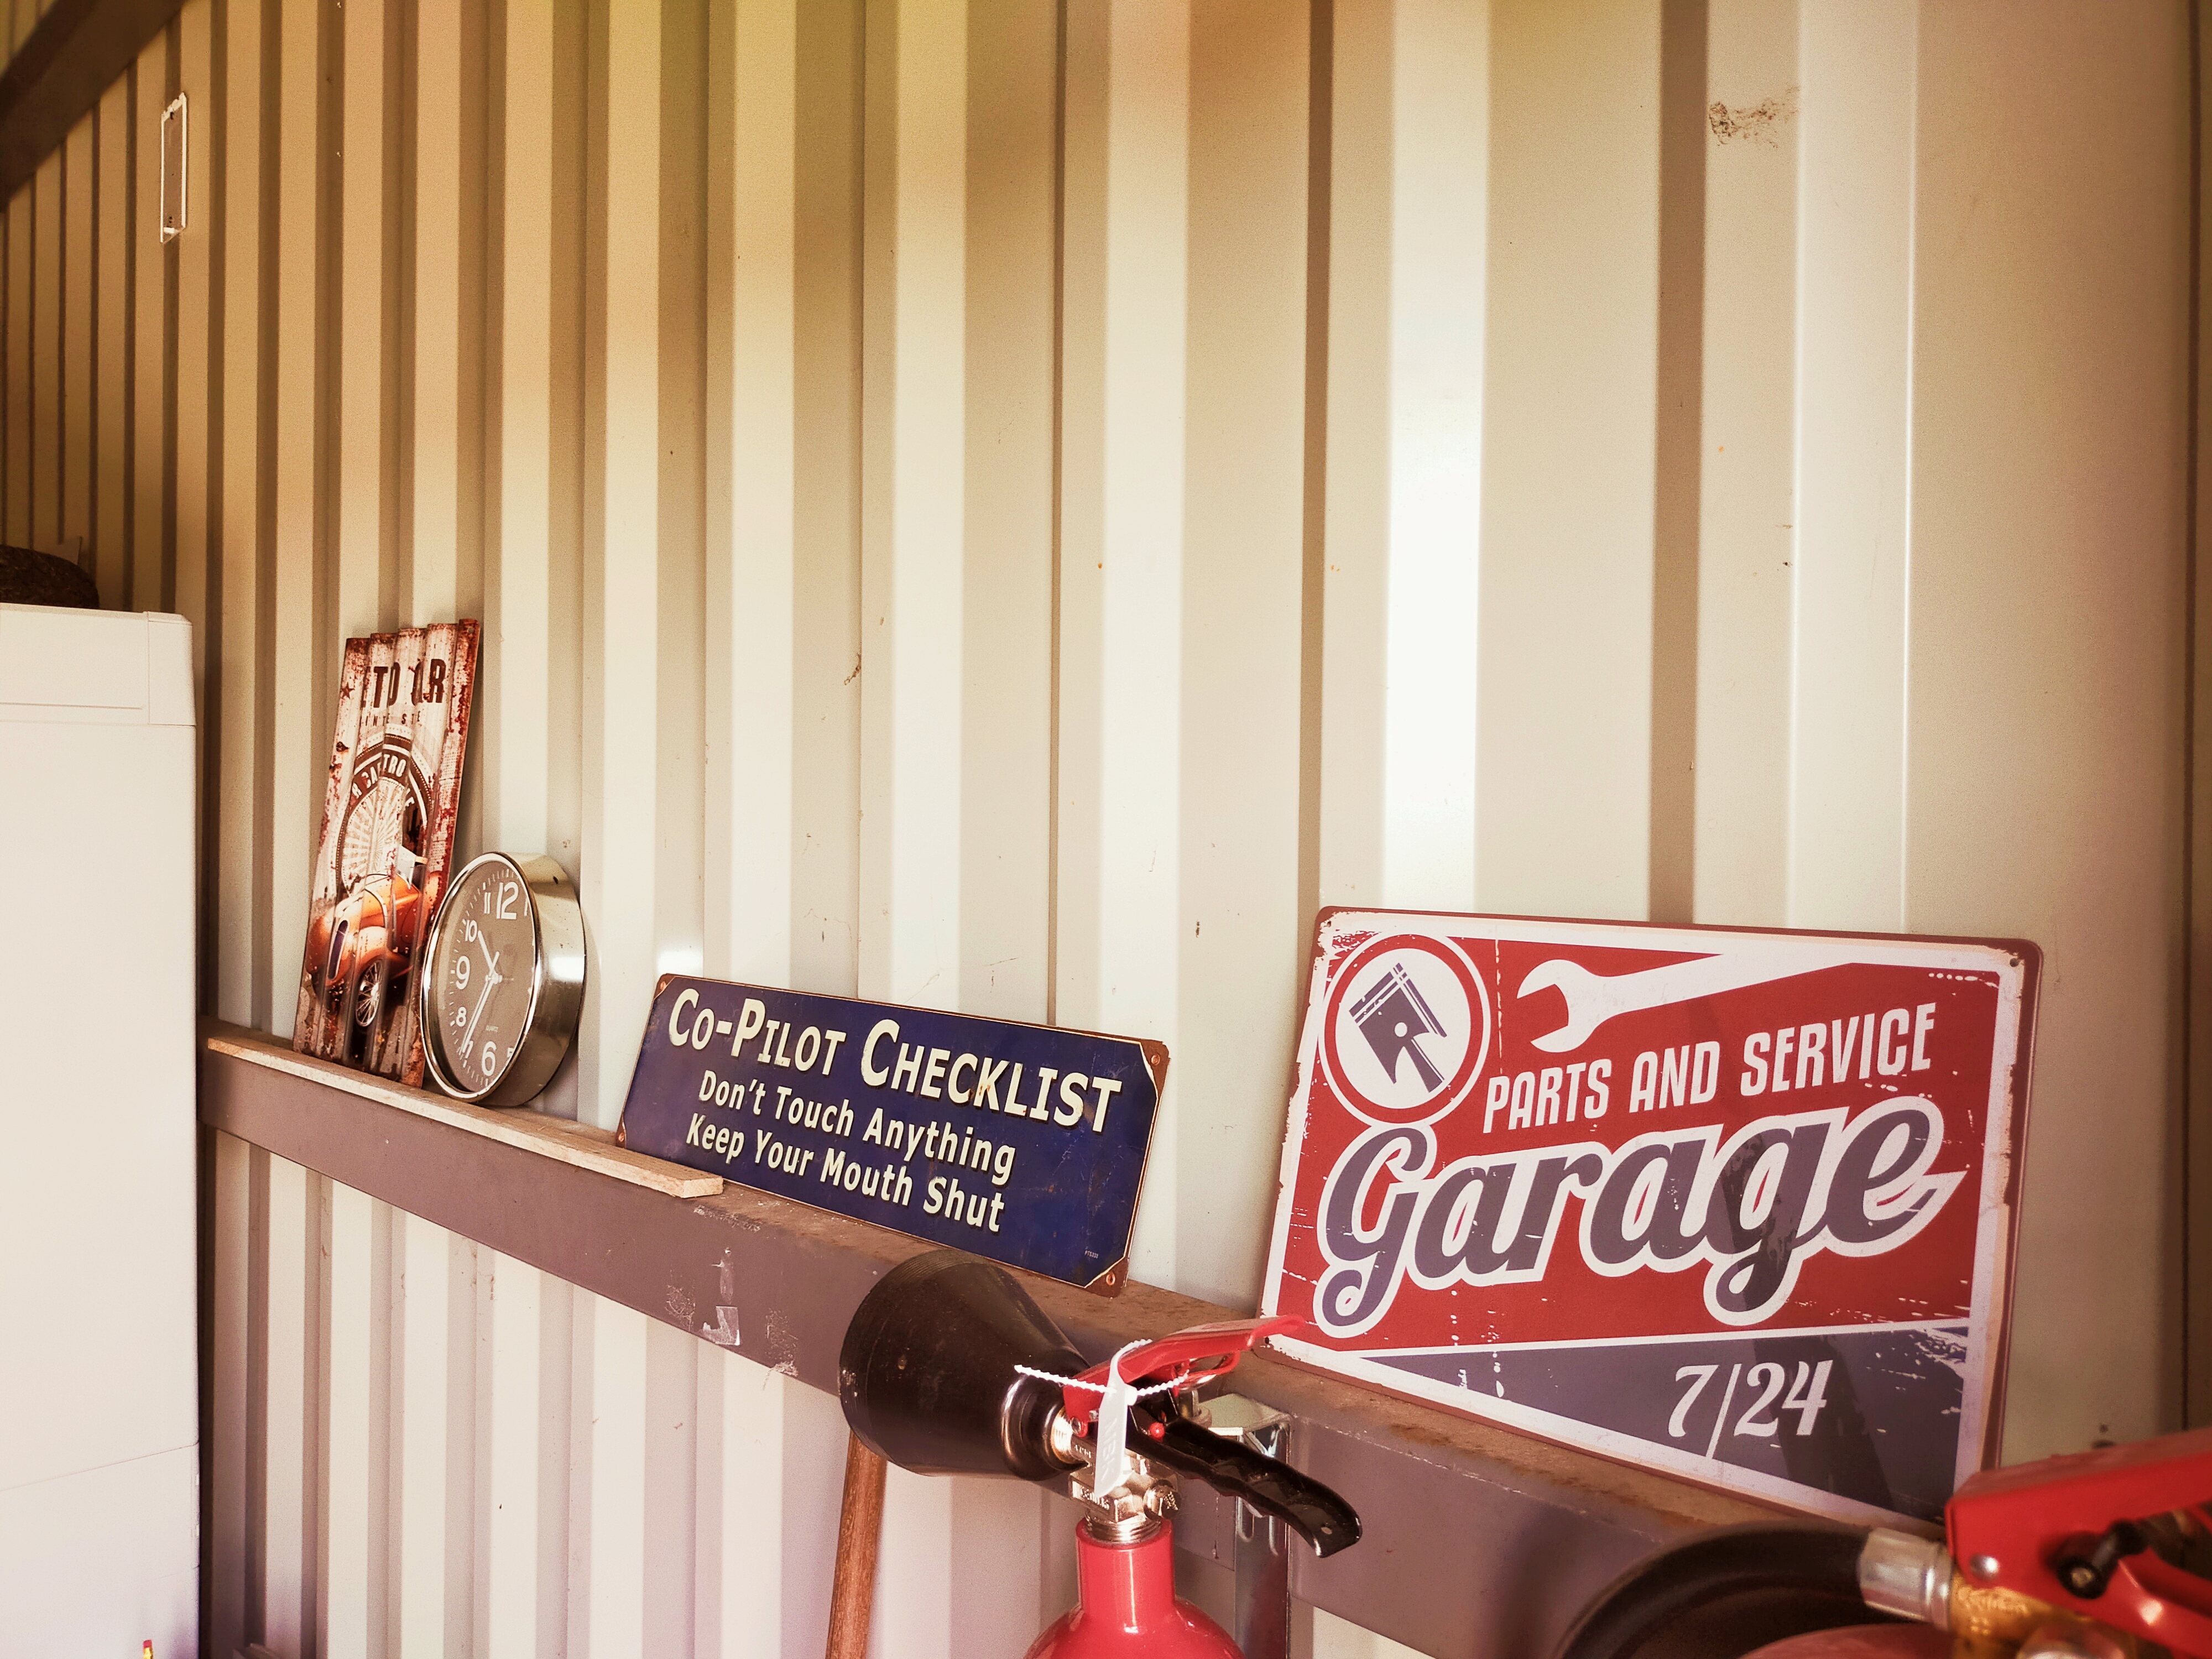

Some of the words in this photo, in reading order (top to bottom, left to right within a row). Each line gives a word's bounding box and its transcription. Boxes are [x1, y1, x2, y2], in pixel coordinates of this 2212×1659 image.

[465, 920, 477, 942] 10
[484, 892, 491, 914] 11
[497, 881, 519, 920] 12
[456, 956, 470, 990] 9
[456, 1006, 467, 1027] 8
[482, 1041, 497, 1076] 6
[861, 1019, 1123, 1133] CHECKLIST
[1483, 1058, 1612, 1134] PARTS
[1629, 1041, 1721, 1113] AND
[1740, 1002, 1937, 1097] SERVICE
[698, 1070, 766, 1115] Don't
[775, 1086, 854, 1137] Touch
[862, 1107, 1016, 1186] Anything
[686, 1113, 745, 1164] Keep
[754, 1129, 815, 1176] Your
[820, 1147, 913, 1206] Mouth
[922, 1175, 1005, 1232] Shut
[1315, 1097, 1964, 1338] Garage
[1668, 1359, 1834, 1459] 7/24
